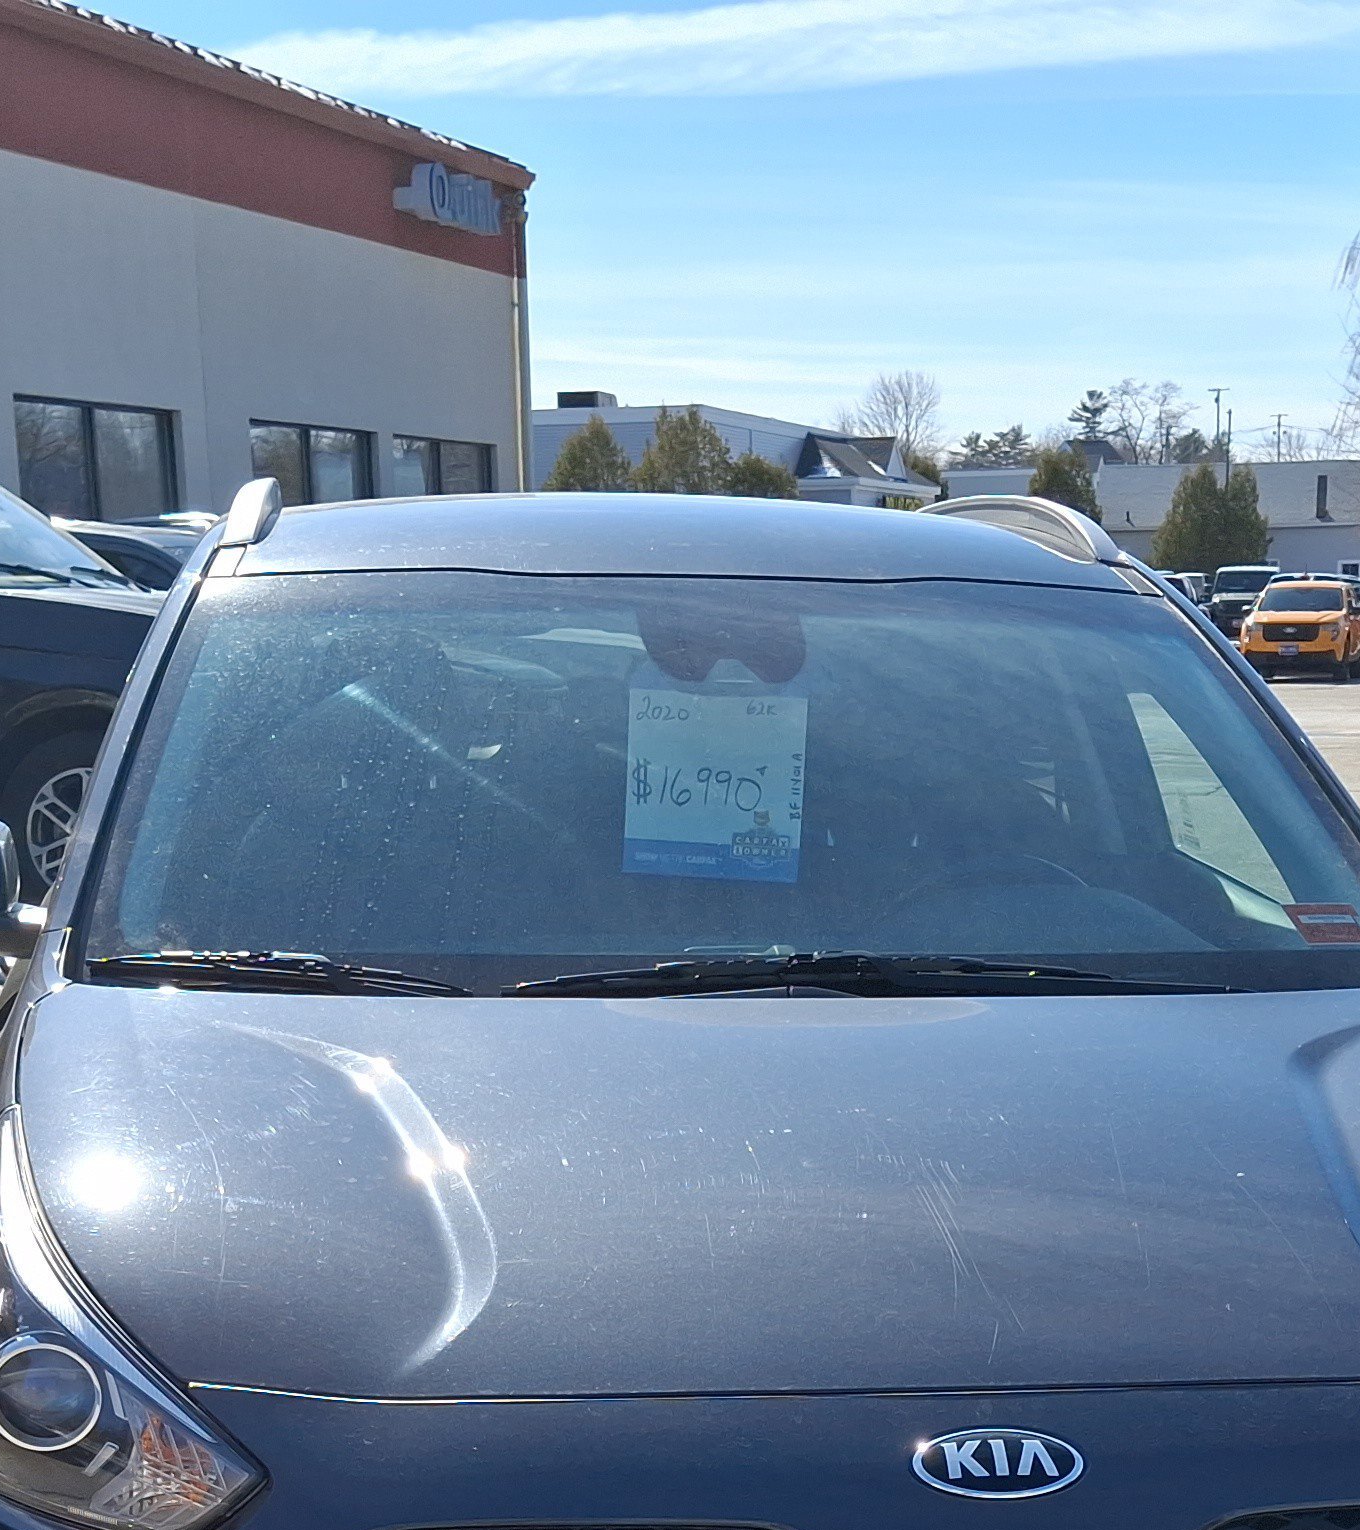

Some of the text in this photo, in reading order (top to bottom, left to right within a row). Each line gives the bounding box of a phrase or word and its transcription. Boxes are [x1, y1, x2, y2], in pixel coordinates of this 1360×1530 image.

[636, 695, 778, 721] 2020 62K
[631, 757, 762, 811] $16990
[941, 1439, 1059, 1479] KIA
